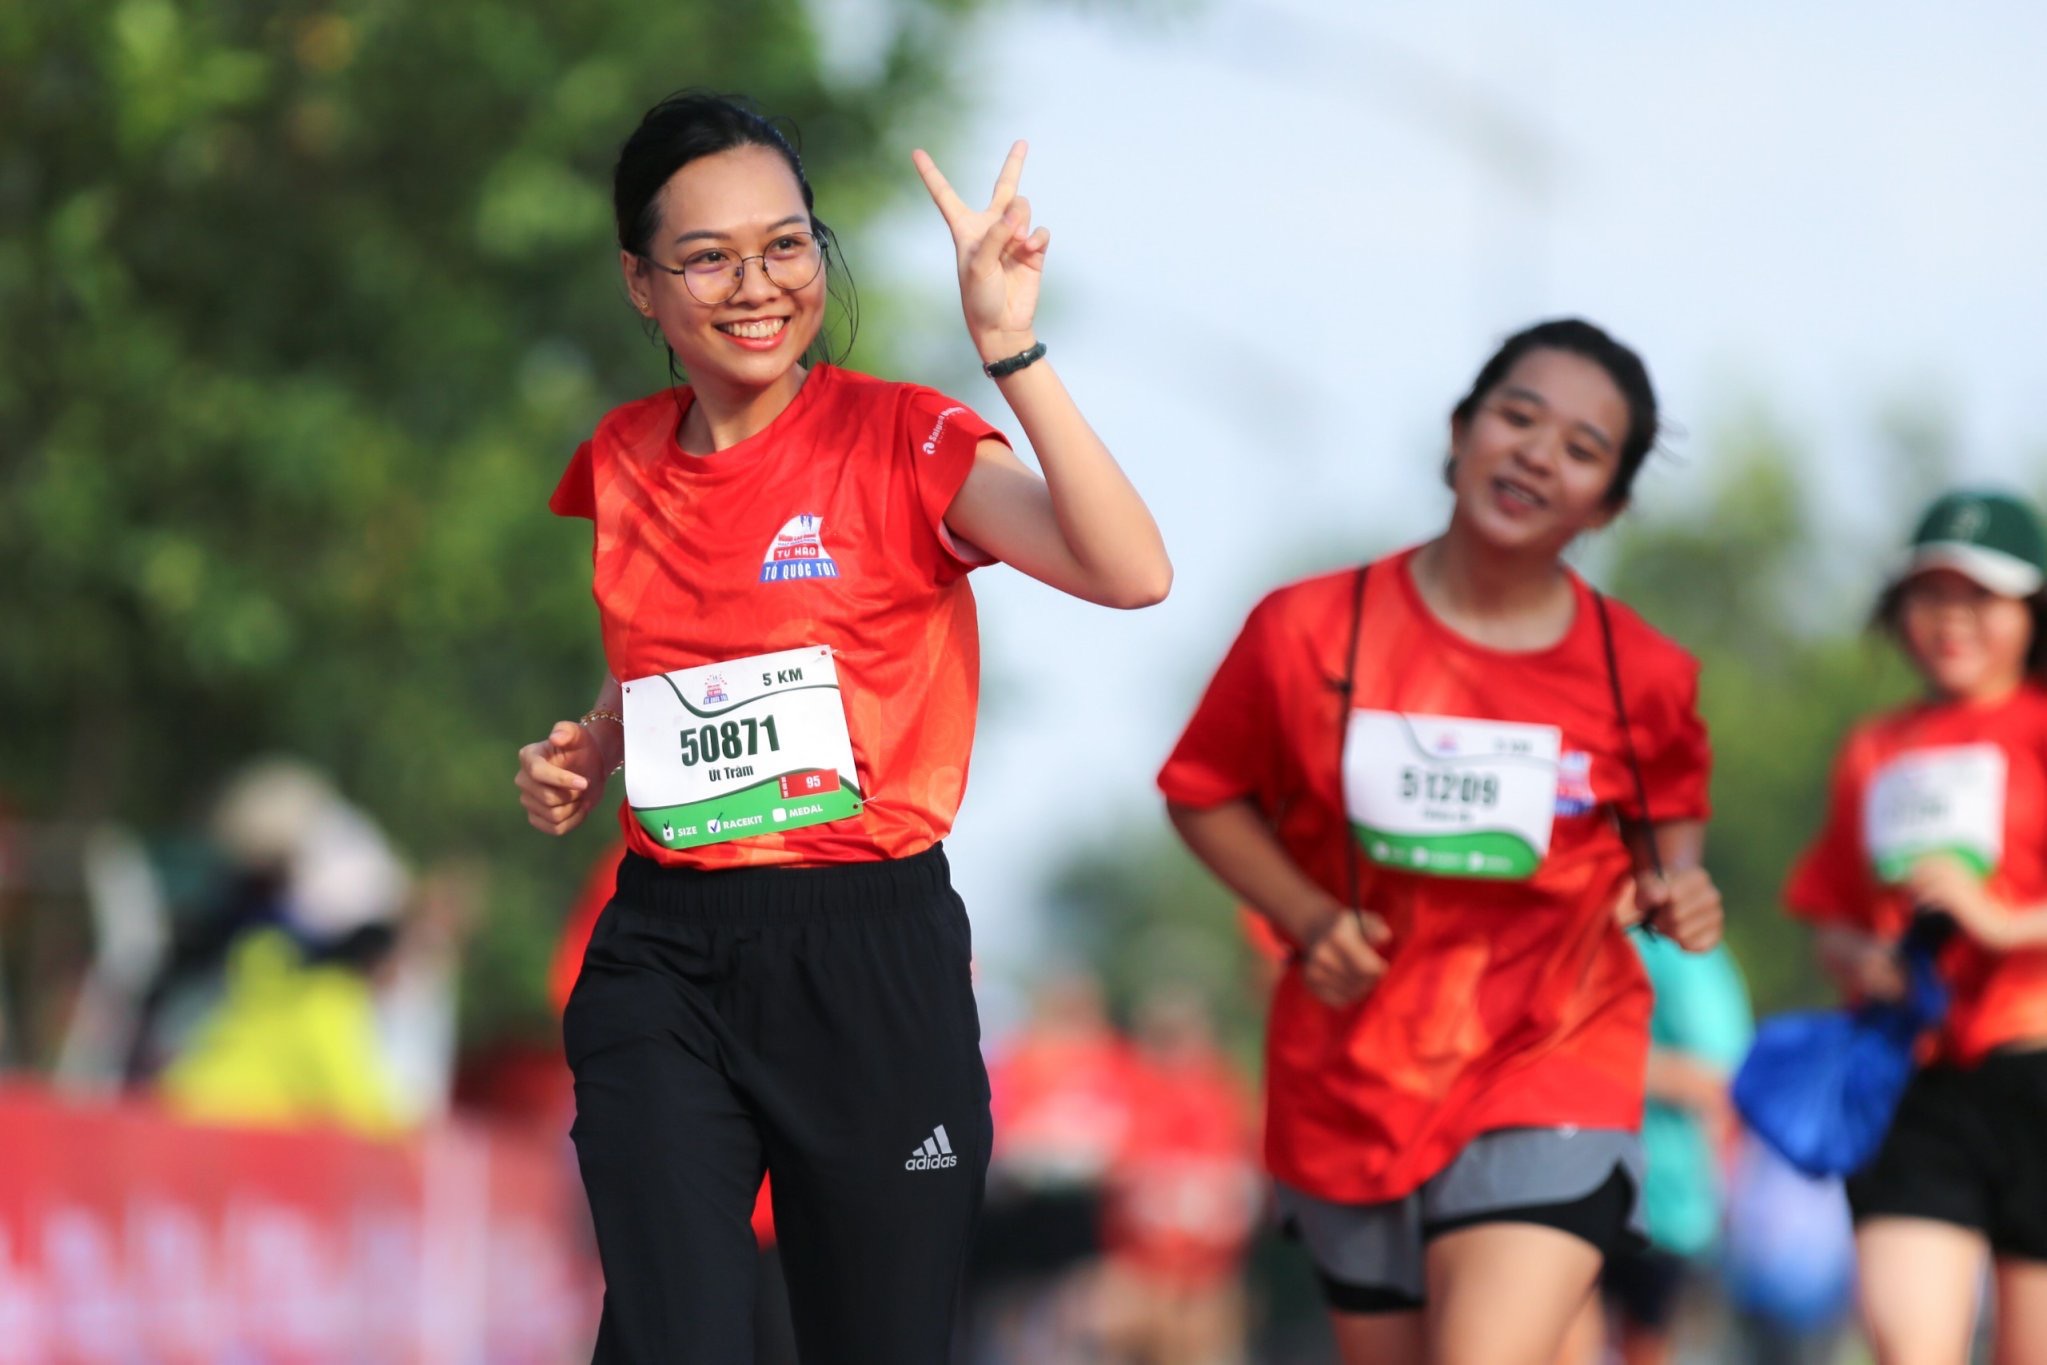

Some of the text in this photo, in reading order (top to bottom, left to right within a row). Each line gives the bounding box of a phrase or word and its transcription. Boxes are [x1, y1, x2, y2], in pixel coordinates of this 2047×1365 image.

[763, 667, 803, 686] 5 KM
[680, 714, 780, 767] 50871
[806, 776, 820, 788] 95
[789, 805, 823, 818] MEDAL
[723, 815, 763, 830] RACEKIT
[677, 826, 697, 837] SIZE
[905, 1154, 957, 1171] adidas
